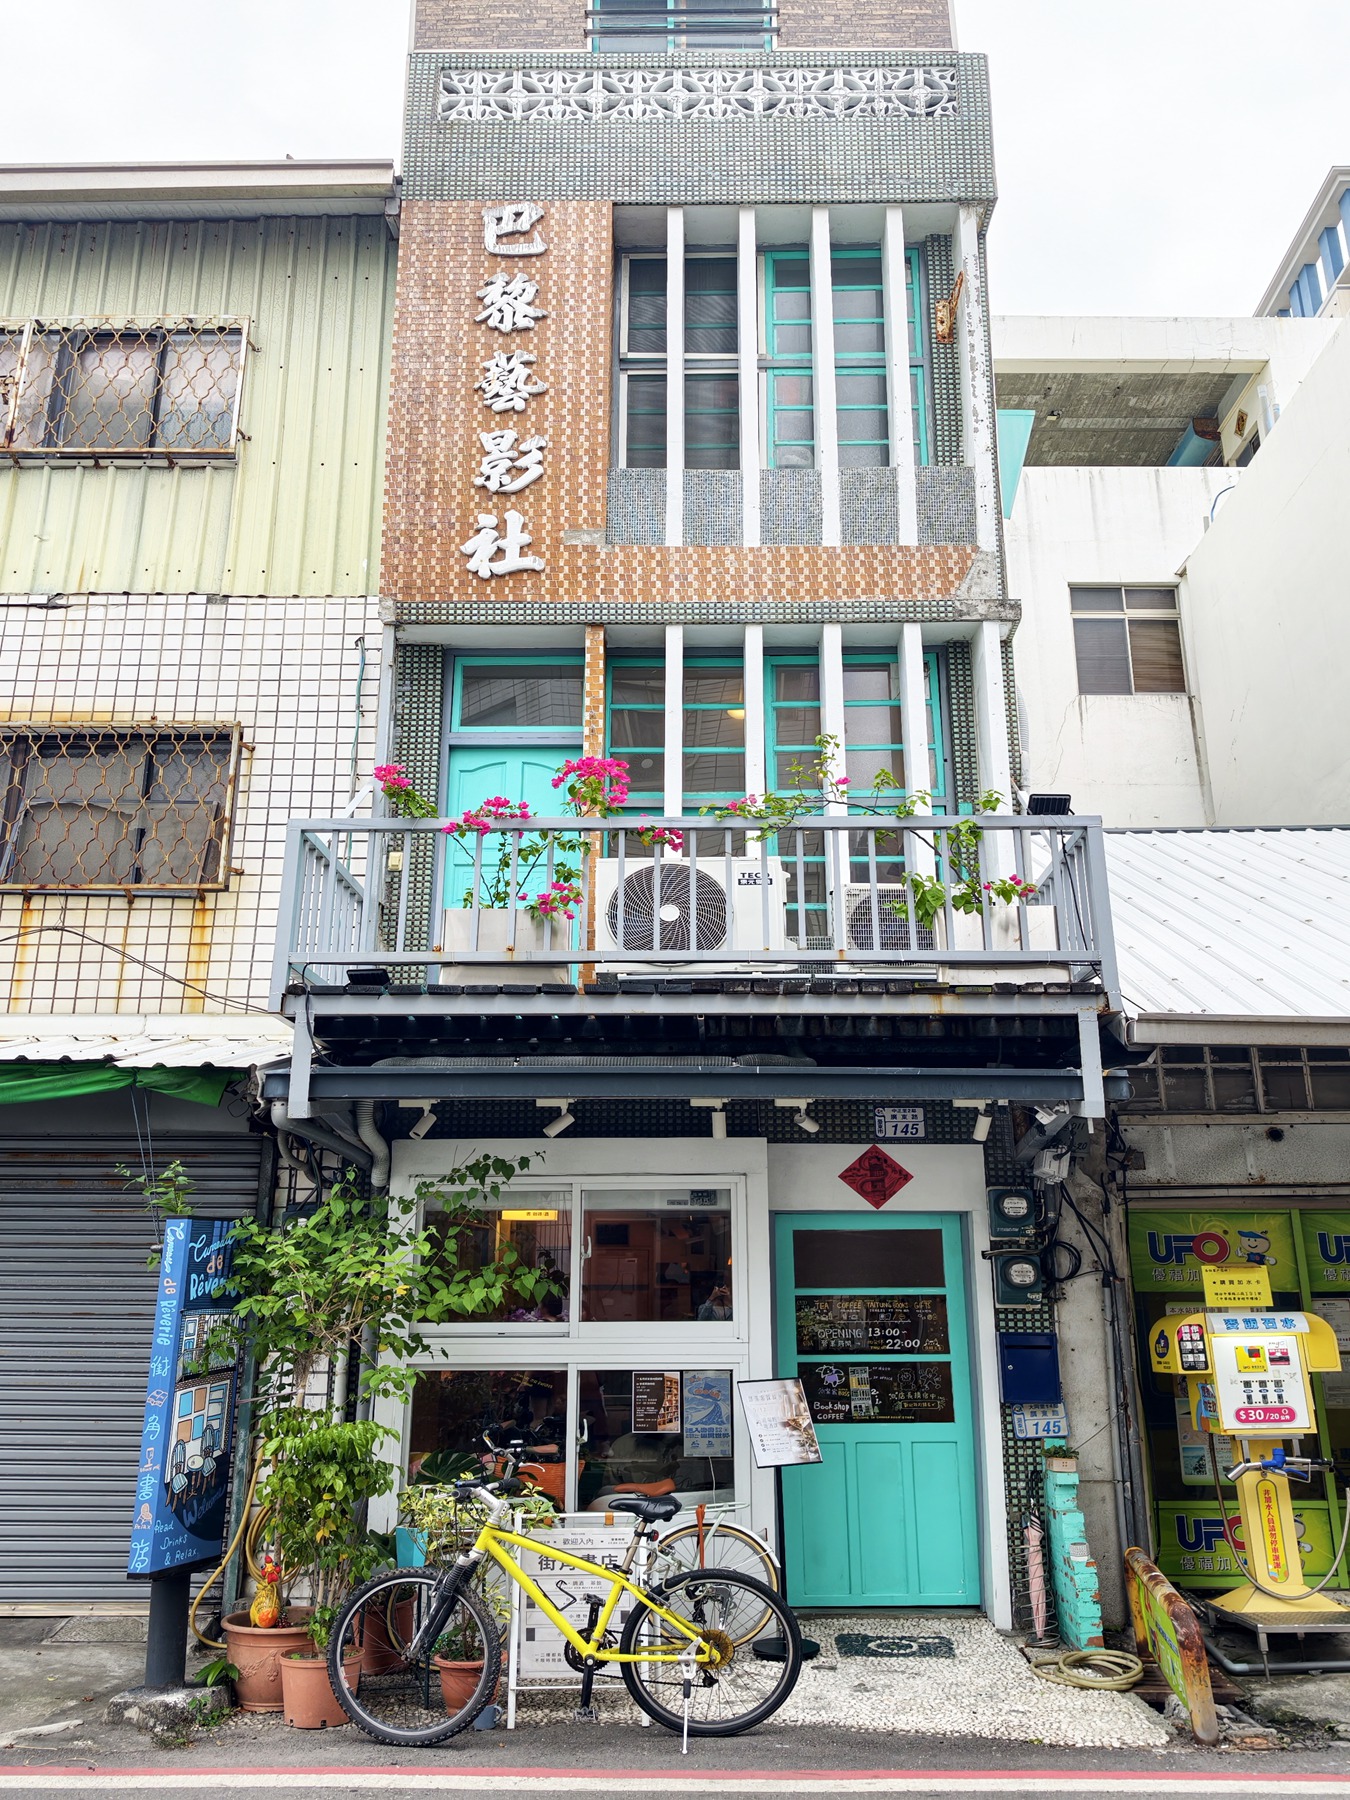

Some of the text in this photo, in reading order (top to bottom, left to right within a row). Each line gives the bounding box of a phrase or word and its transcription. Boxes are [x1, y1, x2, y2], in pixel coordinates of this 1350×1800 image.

[460, 201, 549, 580] 巴黎藝影社
[892, 1123, 919, 1136] 145
[1147, 1231, 1229, 1264] UFO
[207, 1255, 223, 1273] de
[163, 1278, 177, 1295] de
[837, 1301, 861, 1309] COFFEE
[157, 1300, 177, 1346] Rêverie
[1223, 1317, 1297, 1331] 麥飯石水
[818, 1328, 862, 1339] OPENING
[886, 1339, 920, 1349] 22:00
[1032, 1420, 1061, 1435] 145
[155, 1520, 174, 1534] Read
[160, 1534, 188, 1549] Drinks
[164, 1552, 171, 1565] &
